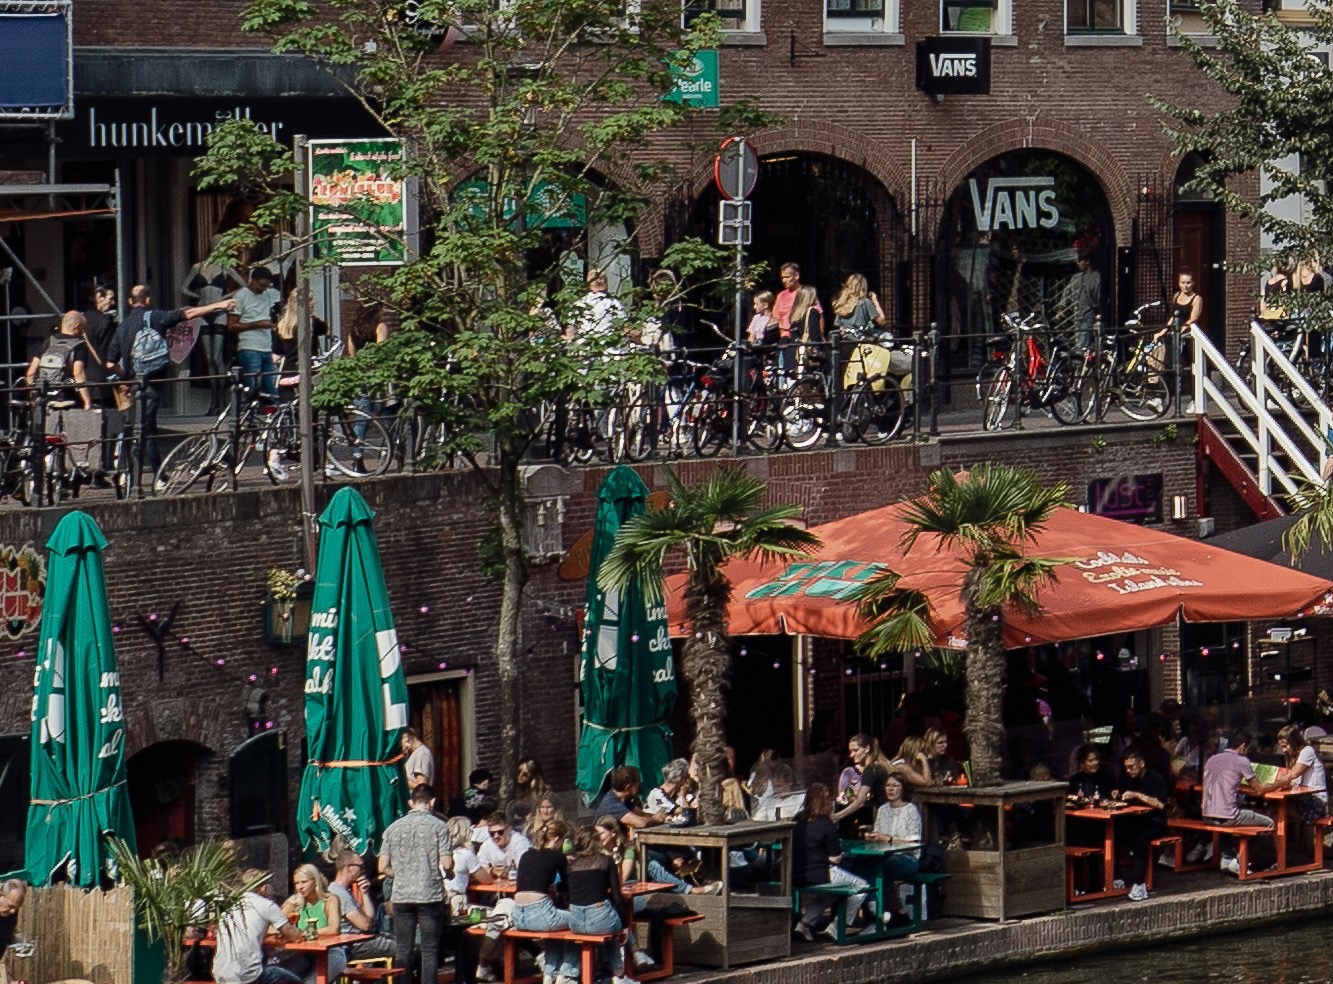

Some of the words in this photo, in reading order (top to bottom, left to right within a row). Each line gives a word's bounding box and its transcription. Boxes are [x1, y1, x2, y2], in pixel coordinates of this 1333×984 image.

[929, 53, 977, 77] VANS
[90, 107, 284, 147] hunkemr
[968, 177, 1060, 231] VANS
